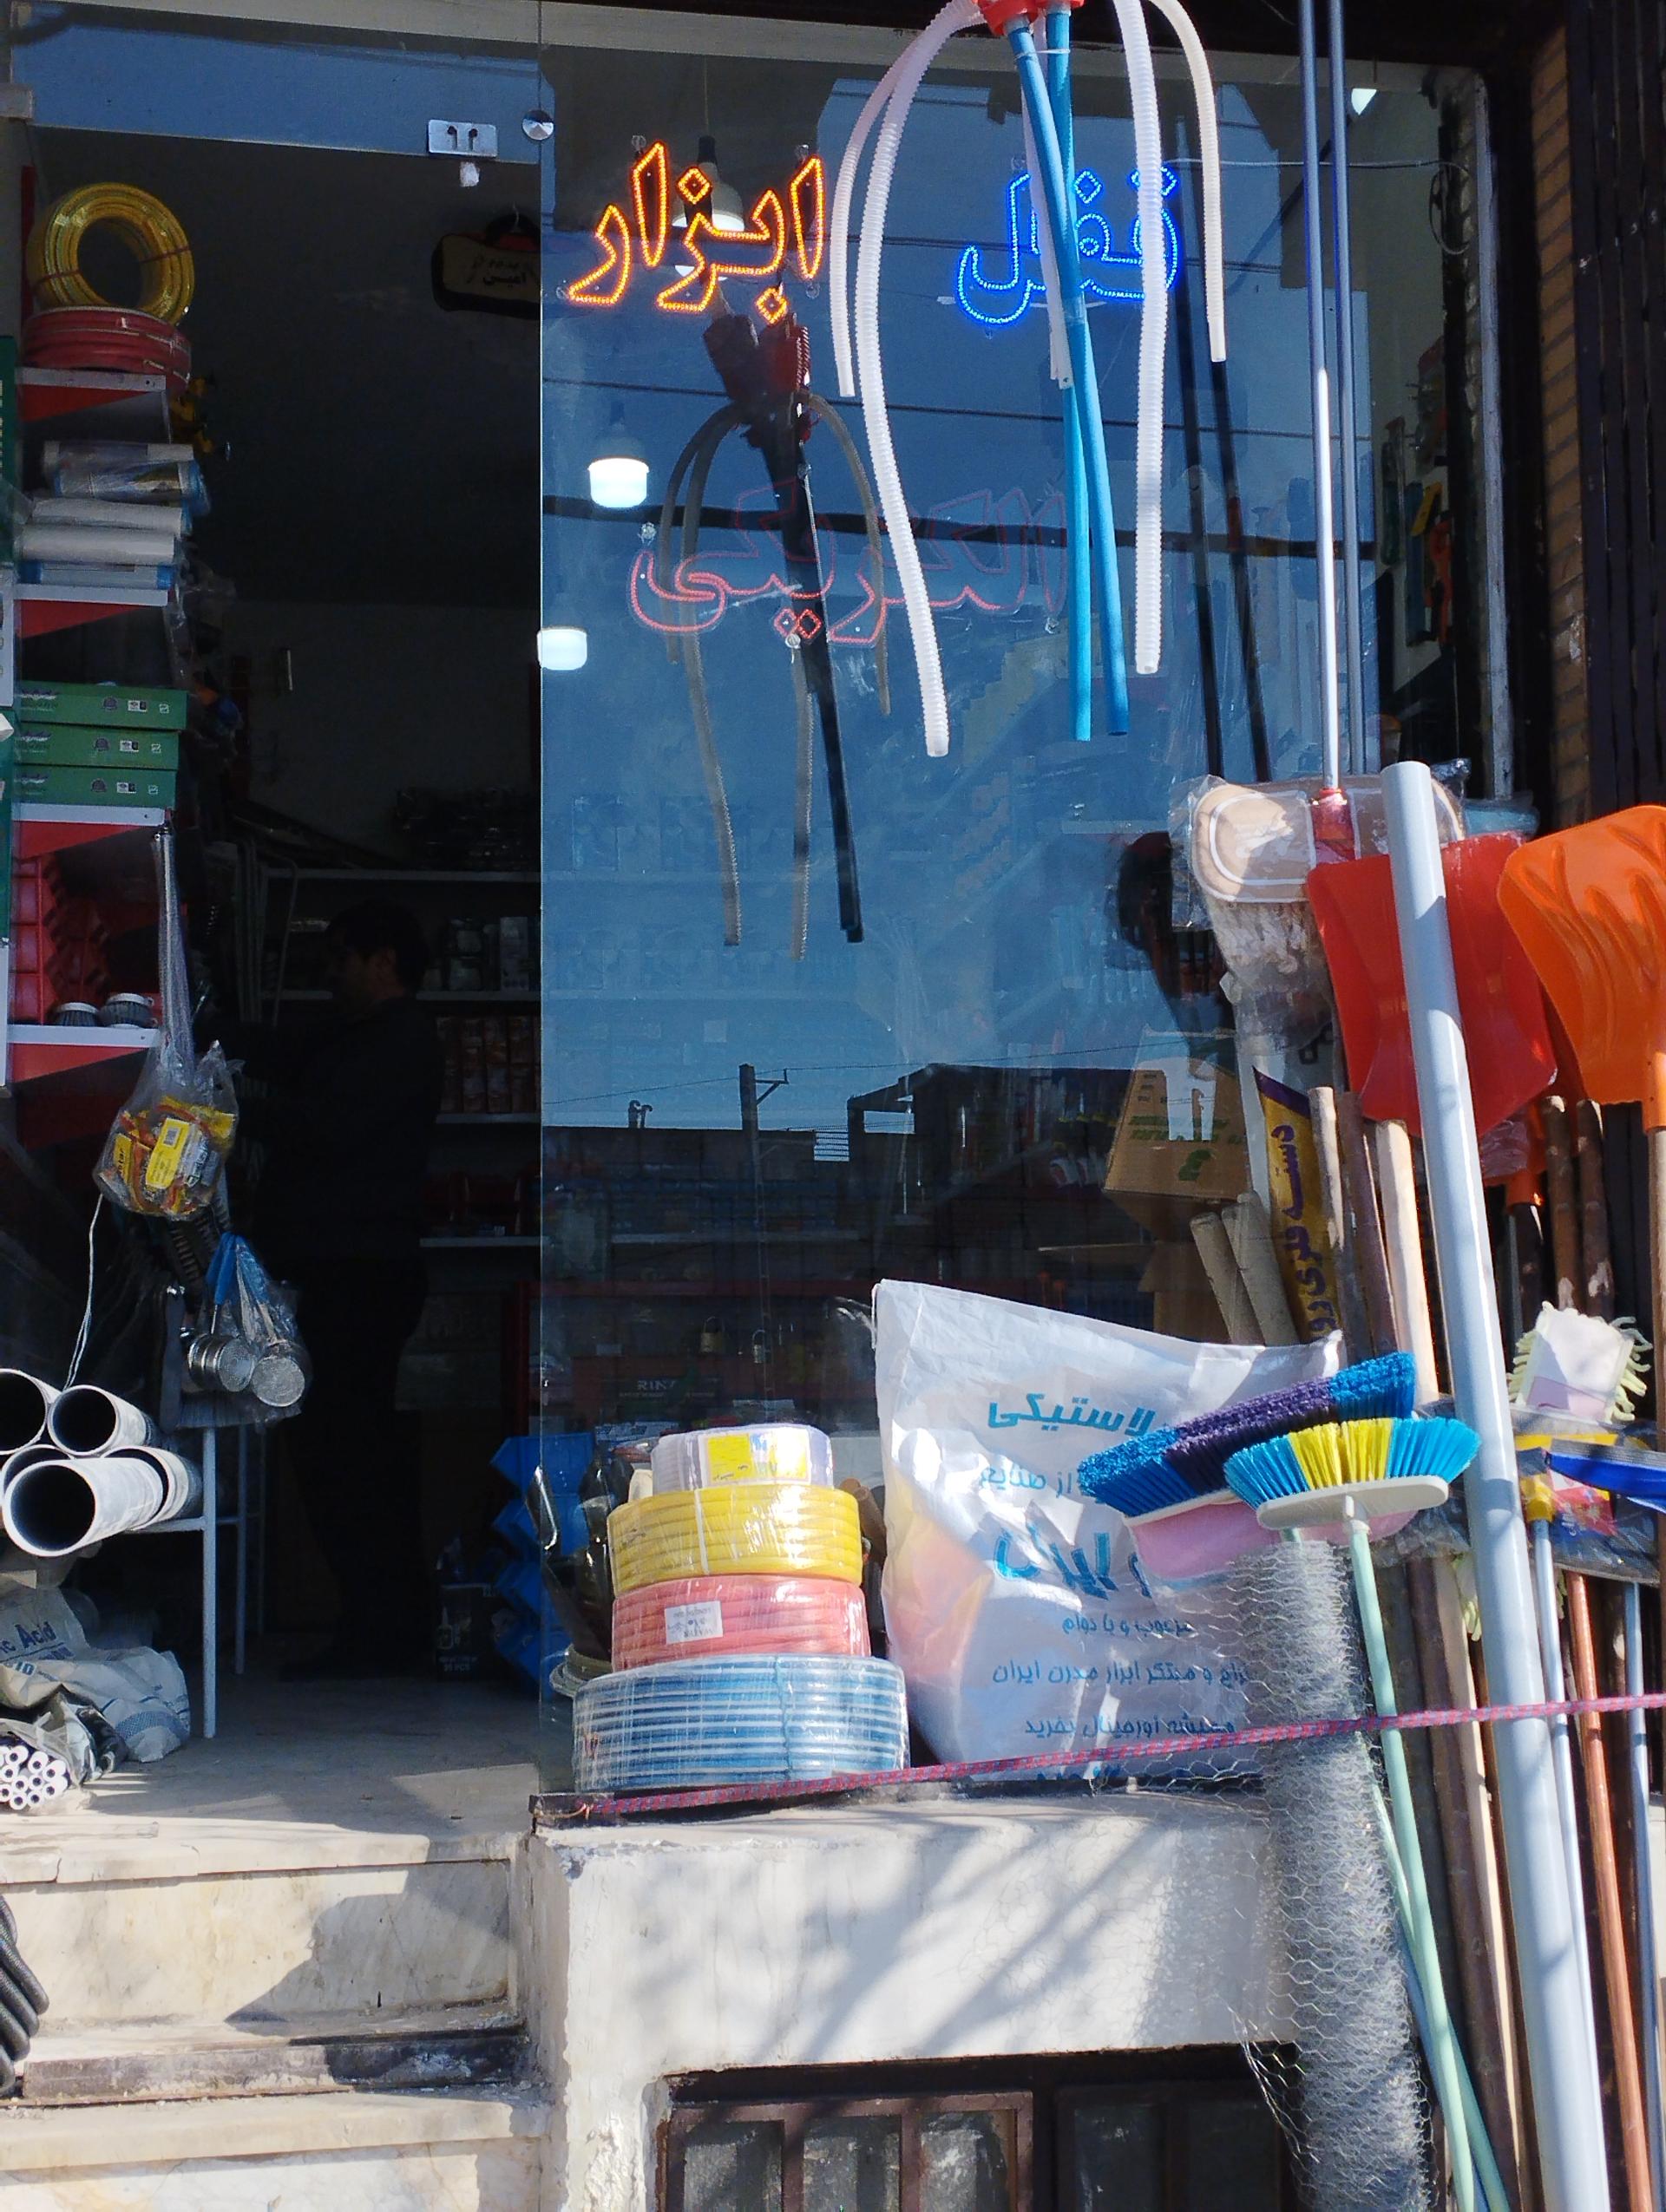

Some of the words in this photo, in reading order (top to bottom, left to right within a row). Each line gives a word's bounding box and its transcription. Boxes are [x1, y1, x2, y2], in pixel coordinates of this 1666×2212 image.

[568, 141, 823, 324] ابزار
[957, 166, 1178, 324] قفل
[14, 1620, 57, 1649] Acid
[1120, 1619, 1131, 1637] و
[992, 1659, 1040, 1685] ایران
[1203, 1666, 1213, 1685] و
